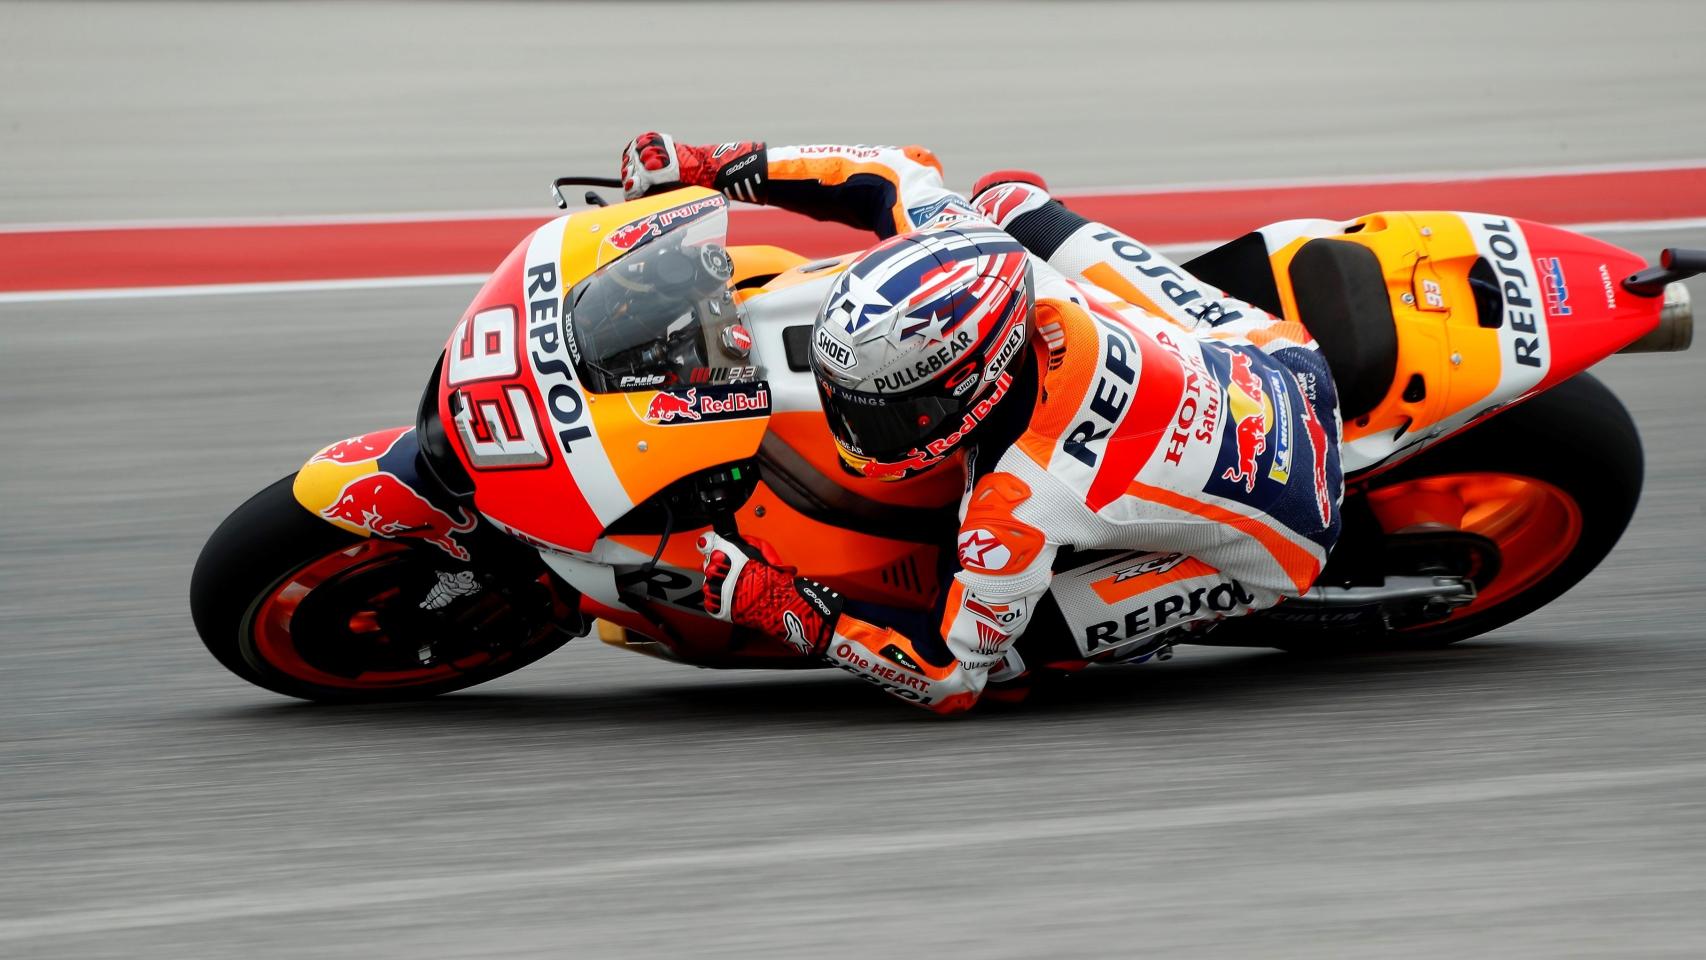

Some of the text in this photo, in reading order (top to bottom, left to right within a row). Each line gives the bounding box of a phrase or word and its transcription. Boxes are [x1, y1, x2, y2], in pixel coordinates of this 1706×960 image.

[1482, 219, 1542, 368] REPSOL
[1599, 264, 1616, 309] HONDA
[527, 262, 593, 454] REPSOL
[565, 312, 582, 365] HONDA
[818, 331, 850, 366] SHOEI
[873, 331, 975, 395] PULL&BEAR
[990, 328, 1025, 382] SHOEI
[448, 303, 551, 470] 93
[620, 374, 666, 385] Puig
[700, 390, 768, 414] Red Bull
[841, 391, 886, 407] WINGS
[956, 375, 976, 394] SHOEI
[926, 371, 1013, 456] Red Bull
[1195, 396, 1220, 445] Satu
[1271, 376, 1288, 448] MICHELIN
[1085, 579, 1255, 652] REPSOL
[836, 644, 931, 694] One HEART.
